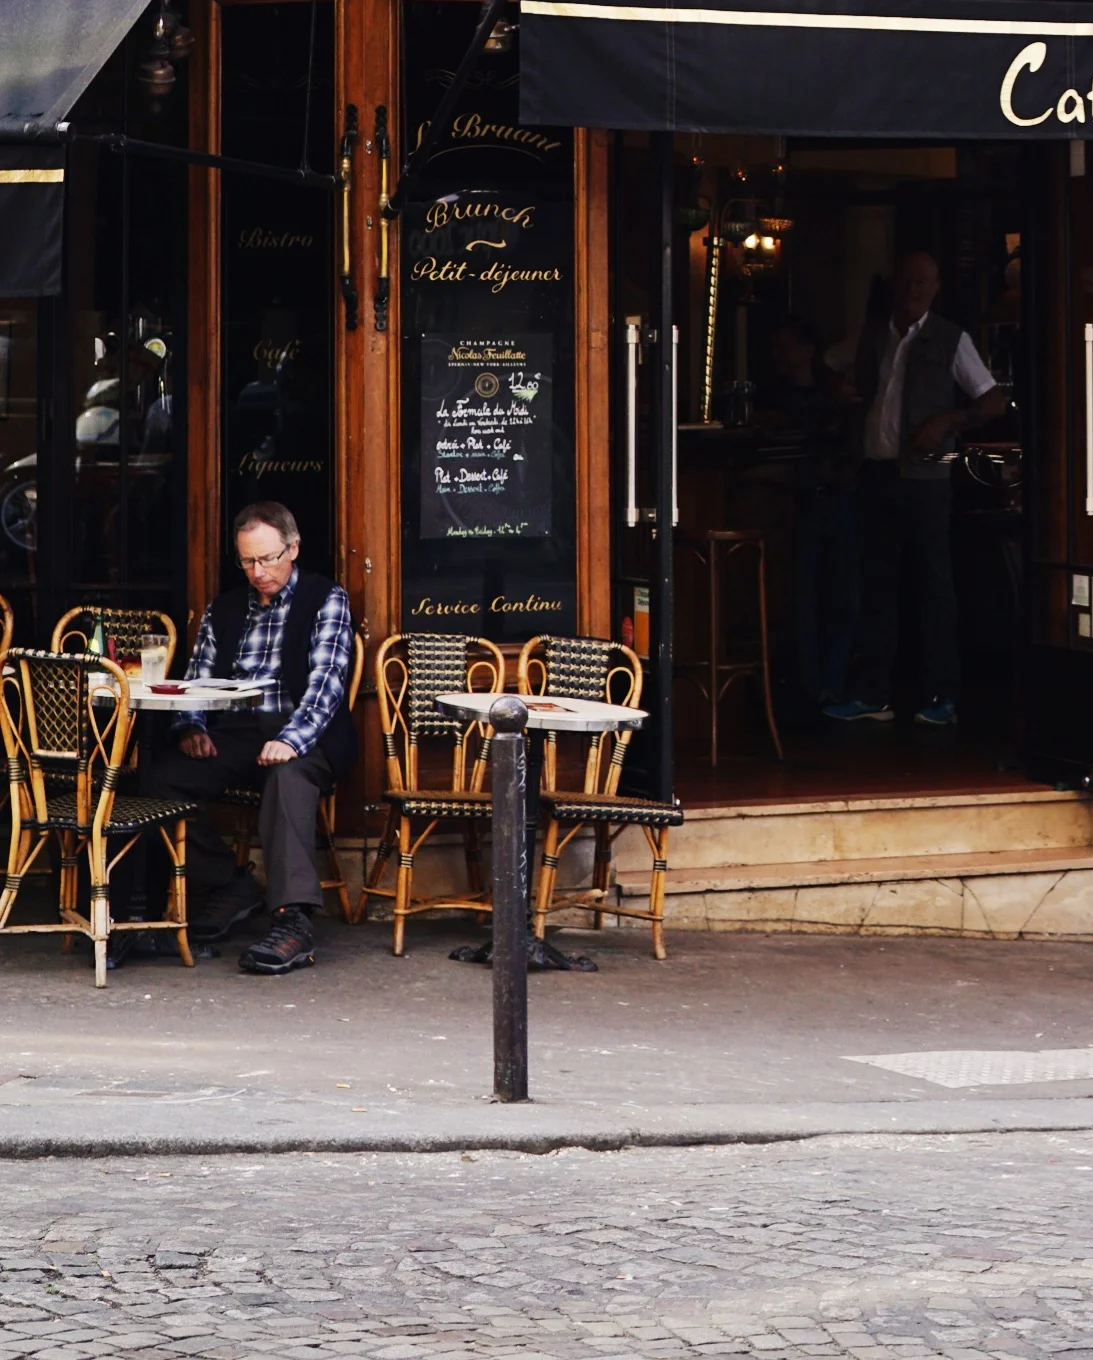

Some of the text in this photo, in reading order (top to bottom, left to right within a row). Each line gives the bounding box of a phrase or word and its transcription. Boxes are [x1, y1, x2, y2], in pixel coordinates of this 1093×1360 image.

[451, 113, 562, 152] Bruant
[425, 200, 536, 233] Brunch
[238, 228, 314, 249] Bistro
[447, 346, 526, 360] Nicolas Feuillatte
[230, 451, 325, 479] Liqueurs
[411, 593, 564, 616] Service Continu
